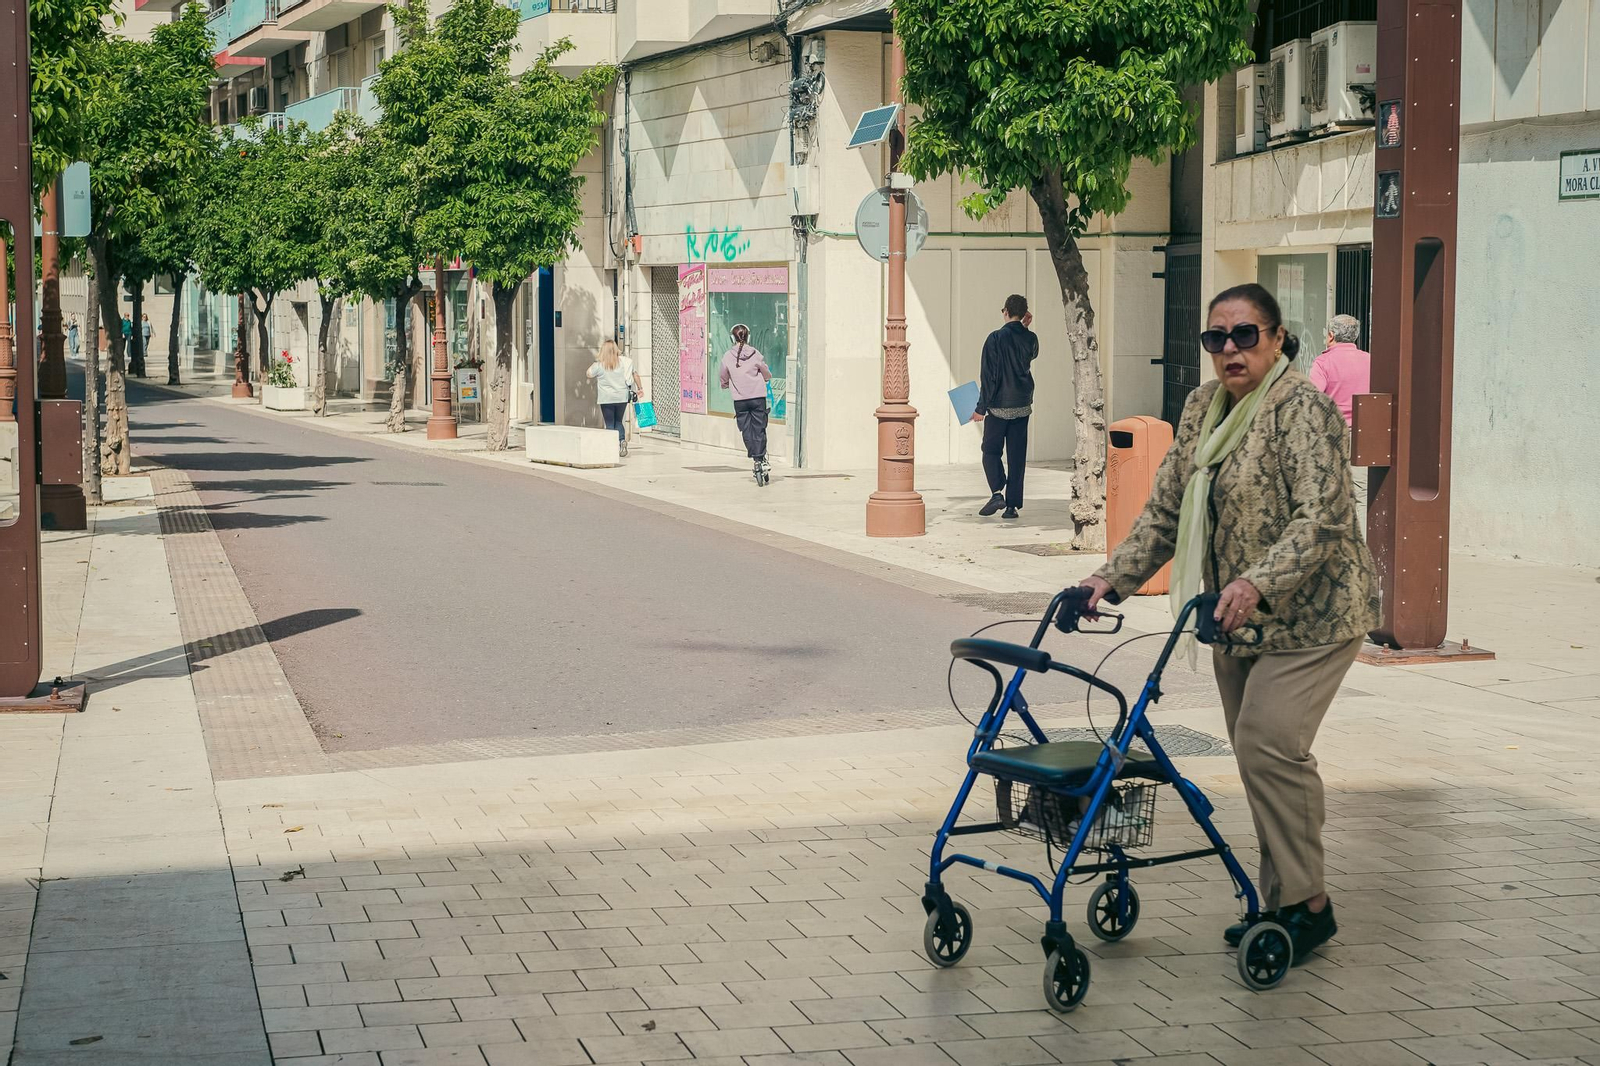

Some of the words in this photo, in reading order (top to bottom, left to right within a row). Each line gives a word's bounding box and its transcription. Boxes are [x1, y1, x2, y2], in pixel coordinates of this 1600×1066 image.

[1582, 158, 1591, 172] A.
[1565, 177, 1588, 192] MORA
[1590, 176, 1600, 190] CL
